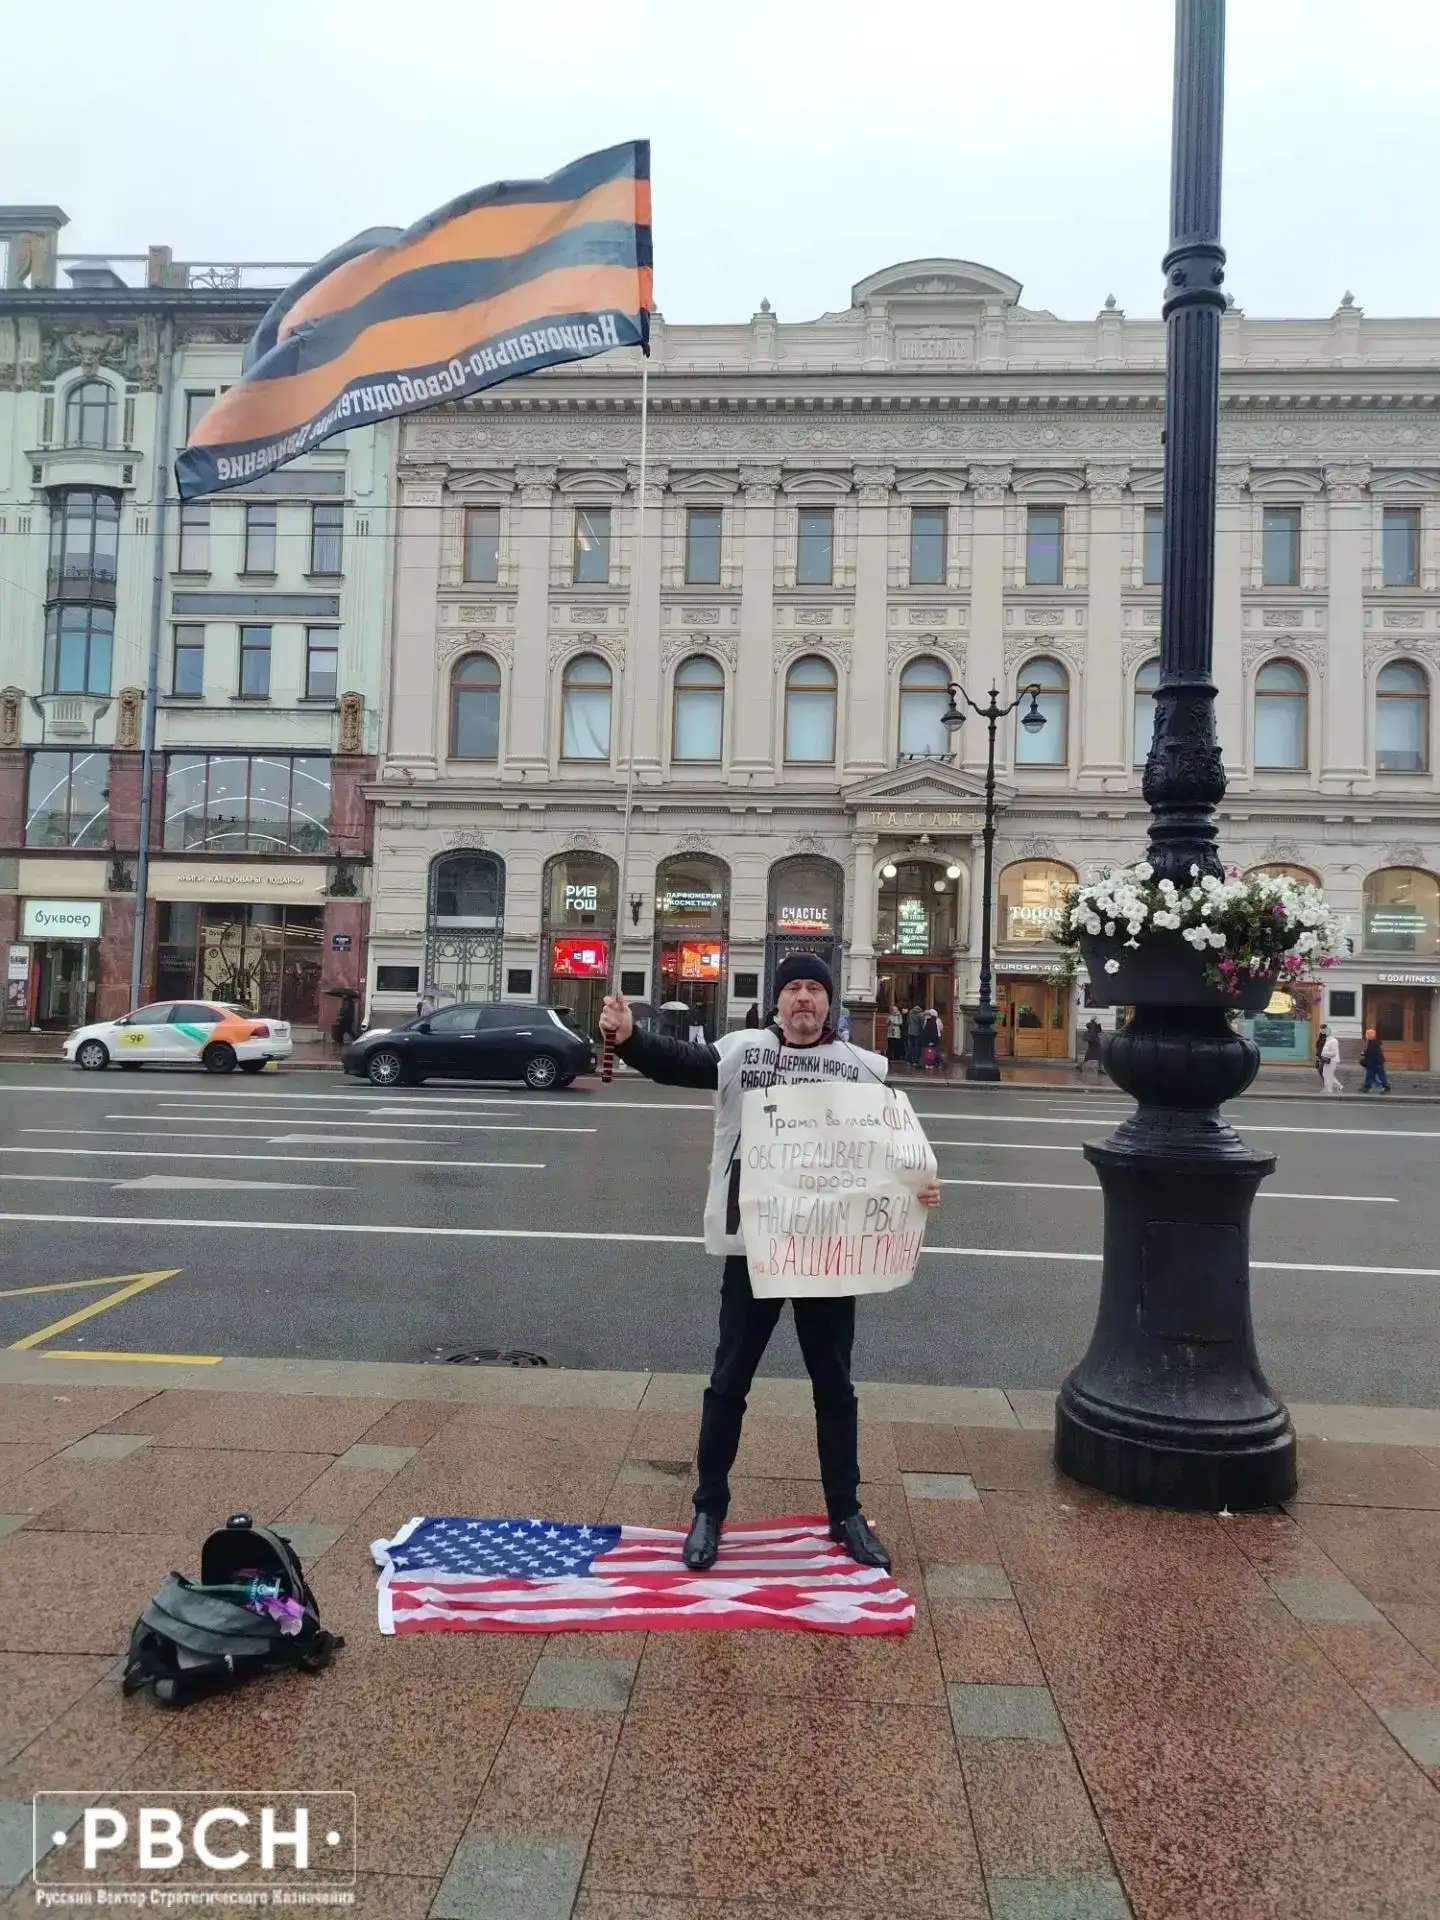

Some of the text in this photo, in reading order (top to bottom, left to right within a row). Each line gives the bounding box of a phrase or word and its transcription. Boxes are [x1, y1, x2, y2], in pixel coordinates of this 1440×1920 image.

[565, 885, 598, 897] РИВ
[666, 892, 722, 900] ПАРФЮМЕРИЯ
[565, 898, 597, 911] ГОШ
[668, 899, 718, 907] КОСМЕТИКА
[35, 910, 91, 928] буквоед
[782, 907, 828, 920] СЧАСТЬЕ
[761, 1048, 820, 1073] ПОДДЕРЖКИ
[822, 1058, 859, 1083] НАРОДА
[741, 1069, 787, 1089] РАБОТАТЬ
[763, 1104, 818, 1136] Трамп
[882, 1105, 915, 1131] США
[748, 1140, 877, 1170] ОБСТРЕЛИВАЕТ
[757, 1195, 912, 1237] НАЦЕЛИМ РВСН
